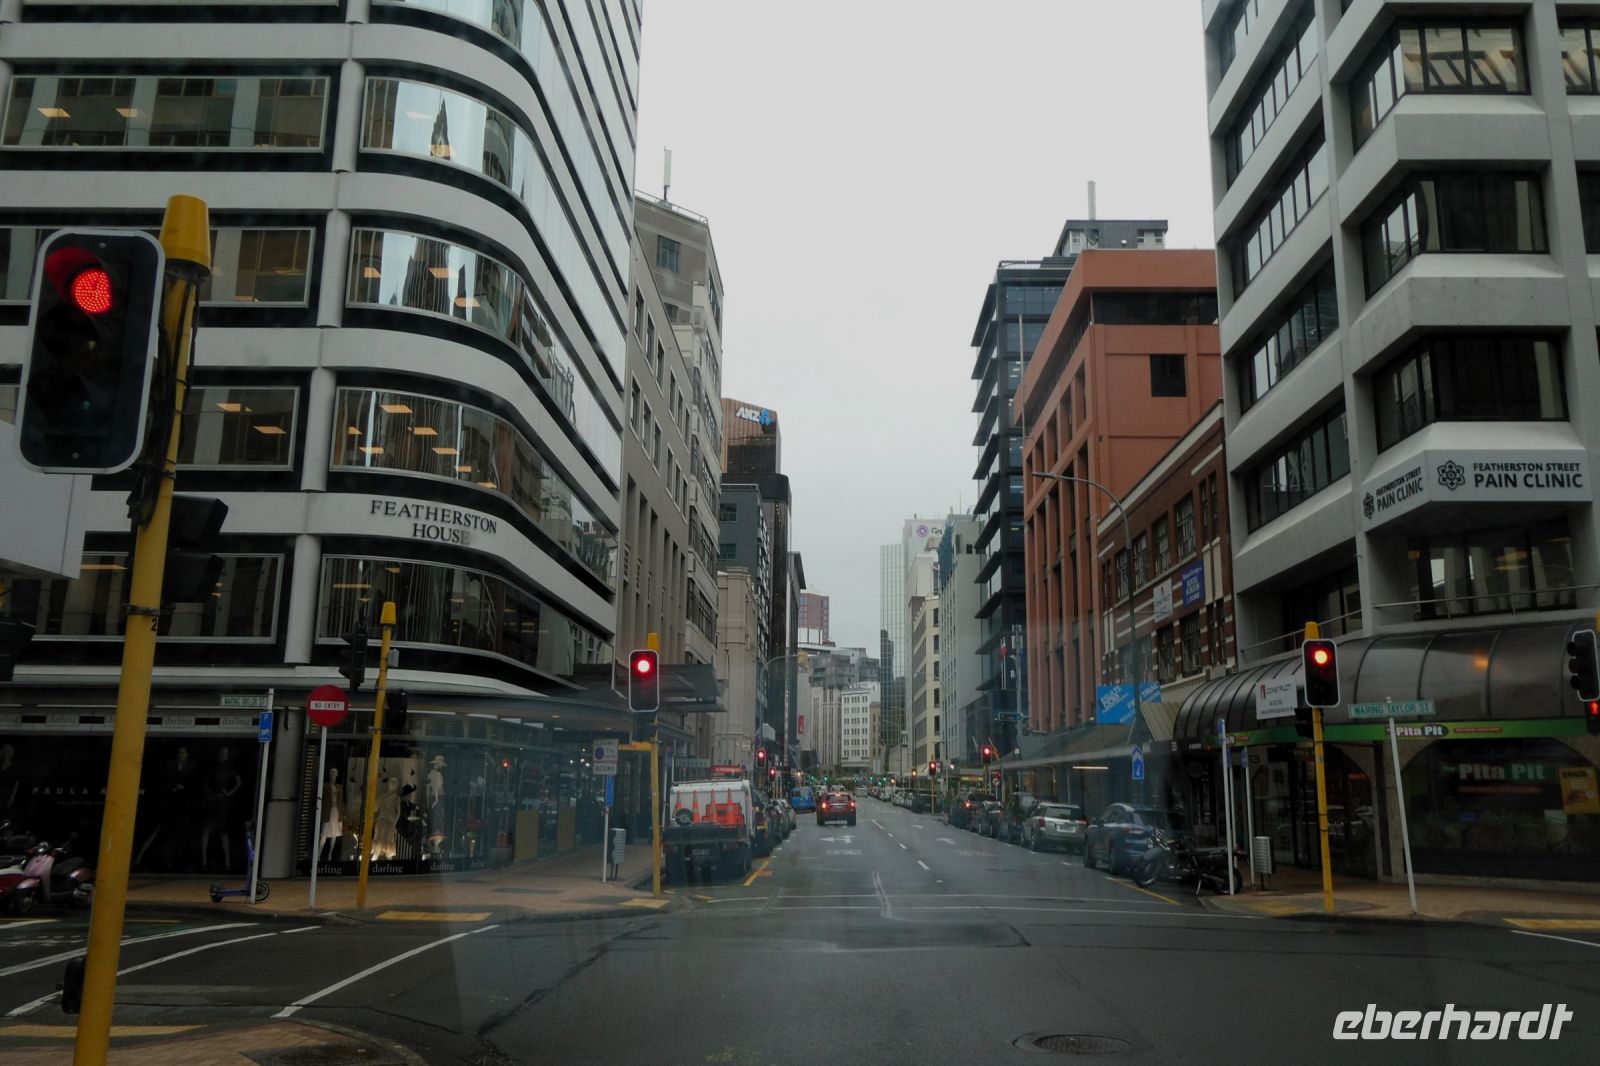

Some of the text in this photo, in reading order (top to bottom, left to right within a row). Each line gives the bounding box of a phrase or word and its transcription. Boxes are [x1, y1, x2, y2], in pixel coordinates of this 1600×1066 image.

[736, 407, 760, 422] ANZ
[1473, 463, 1581, 472] FEATHERSTON STREET
[1375, 467, 1422, 497] FEATHERSTON STREET
[1474, 473, 1584, 488] PAIN CLINIC
[1376, 477, 1424, 512] PAIN CLINIC
[370, 500, 497, 534] FEATHERSTON
[412, 522, 471, 545] HOUSE
[1353, 702, 1429, 714] WARING TAYLOR ST
[1396, 726, 1422, 736] Pita
[1424, 726, 1443, 736] Pit
[1458, 763, 1505, 780] Pita
[1511, 763, 1545, 780] Pit
[32, 786, 89, 796] PAULA
[372, 861, 403, 874] darling
